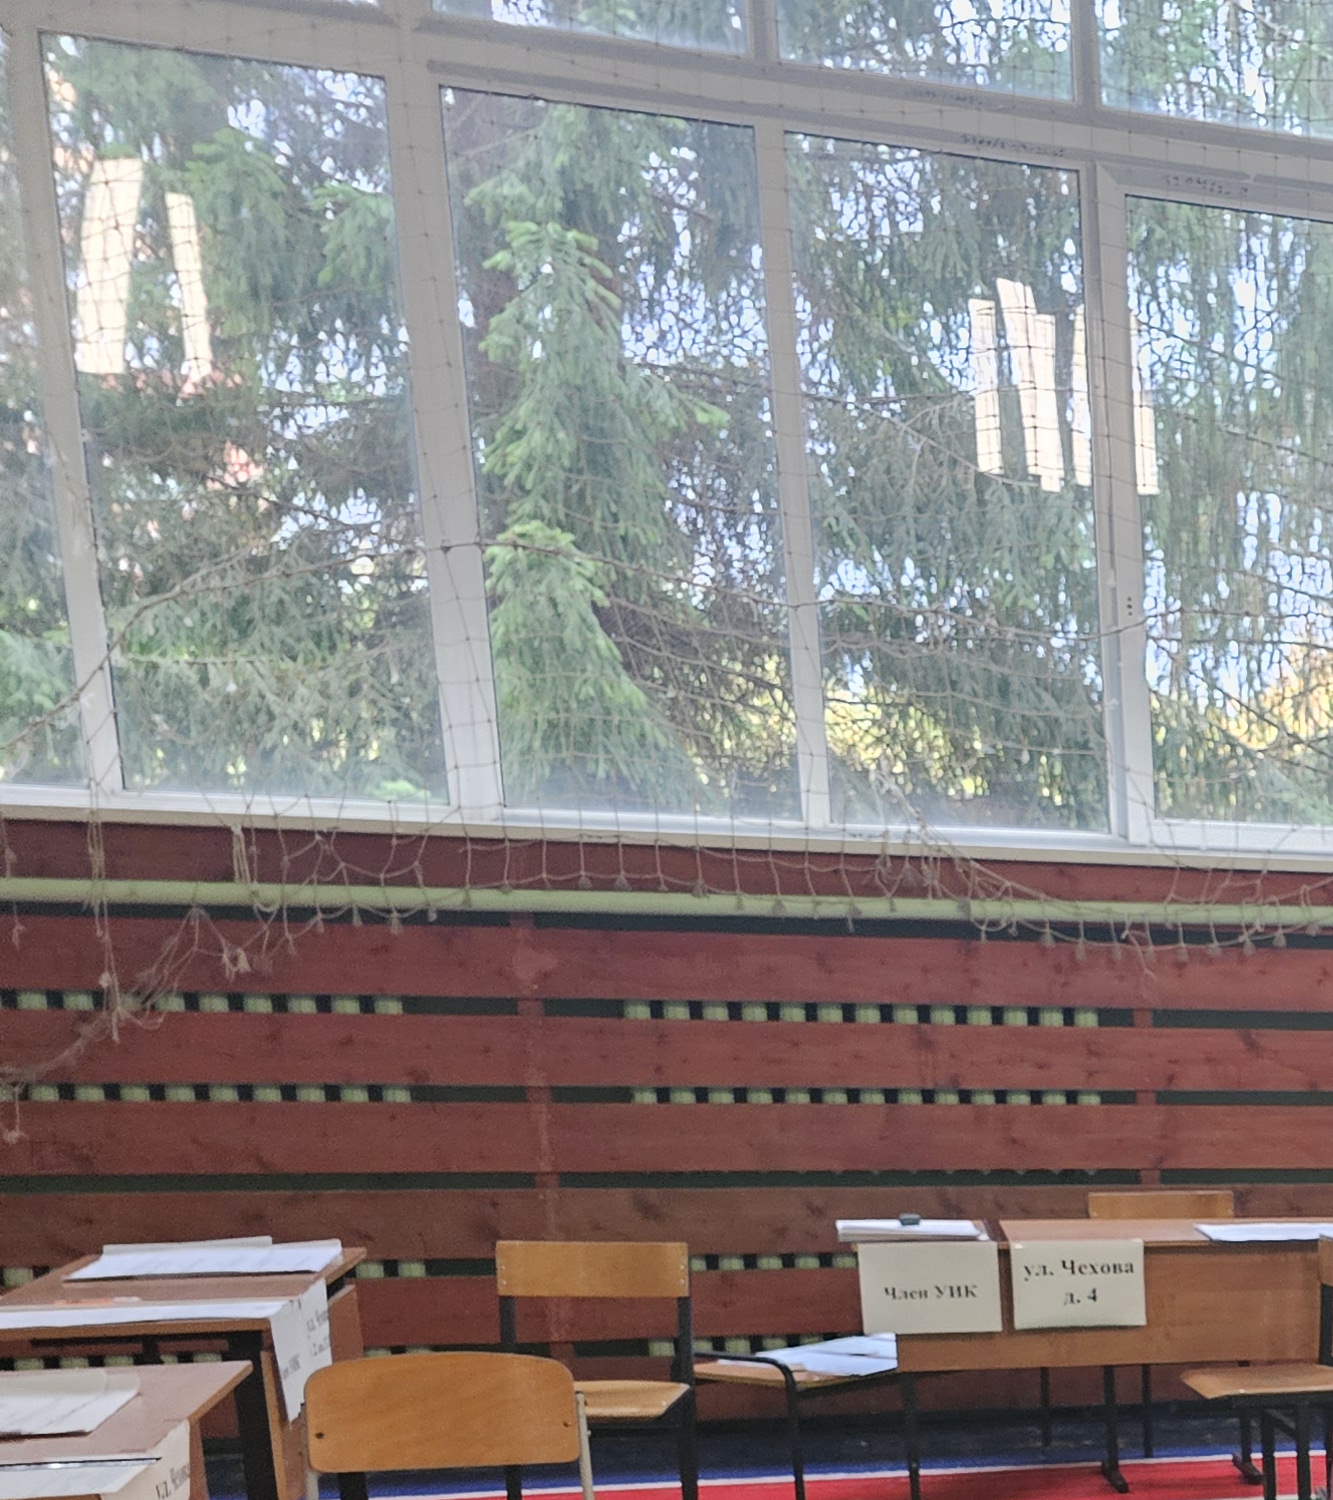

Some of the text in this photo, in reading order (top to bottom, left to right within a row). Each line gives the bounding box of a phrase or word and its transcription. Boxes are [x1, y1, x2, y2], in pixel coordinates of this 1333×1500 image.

[1023, 1259, 1135, 1282] ул. Чехова
[884, 1284, 978, 1300] Член УИК
[1087, 1288, 1098, 1303] 4
